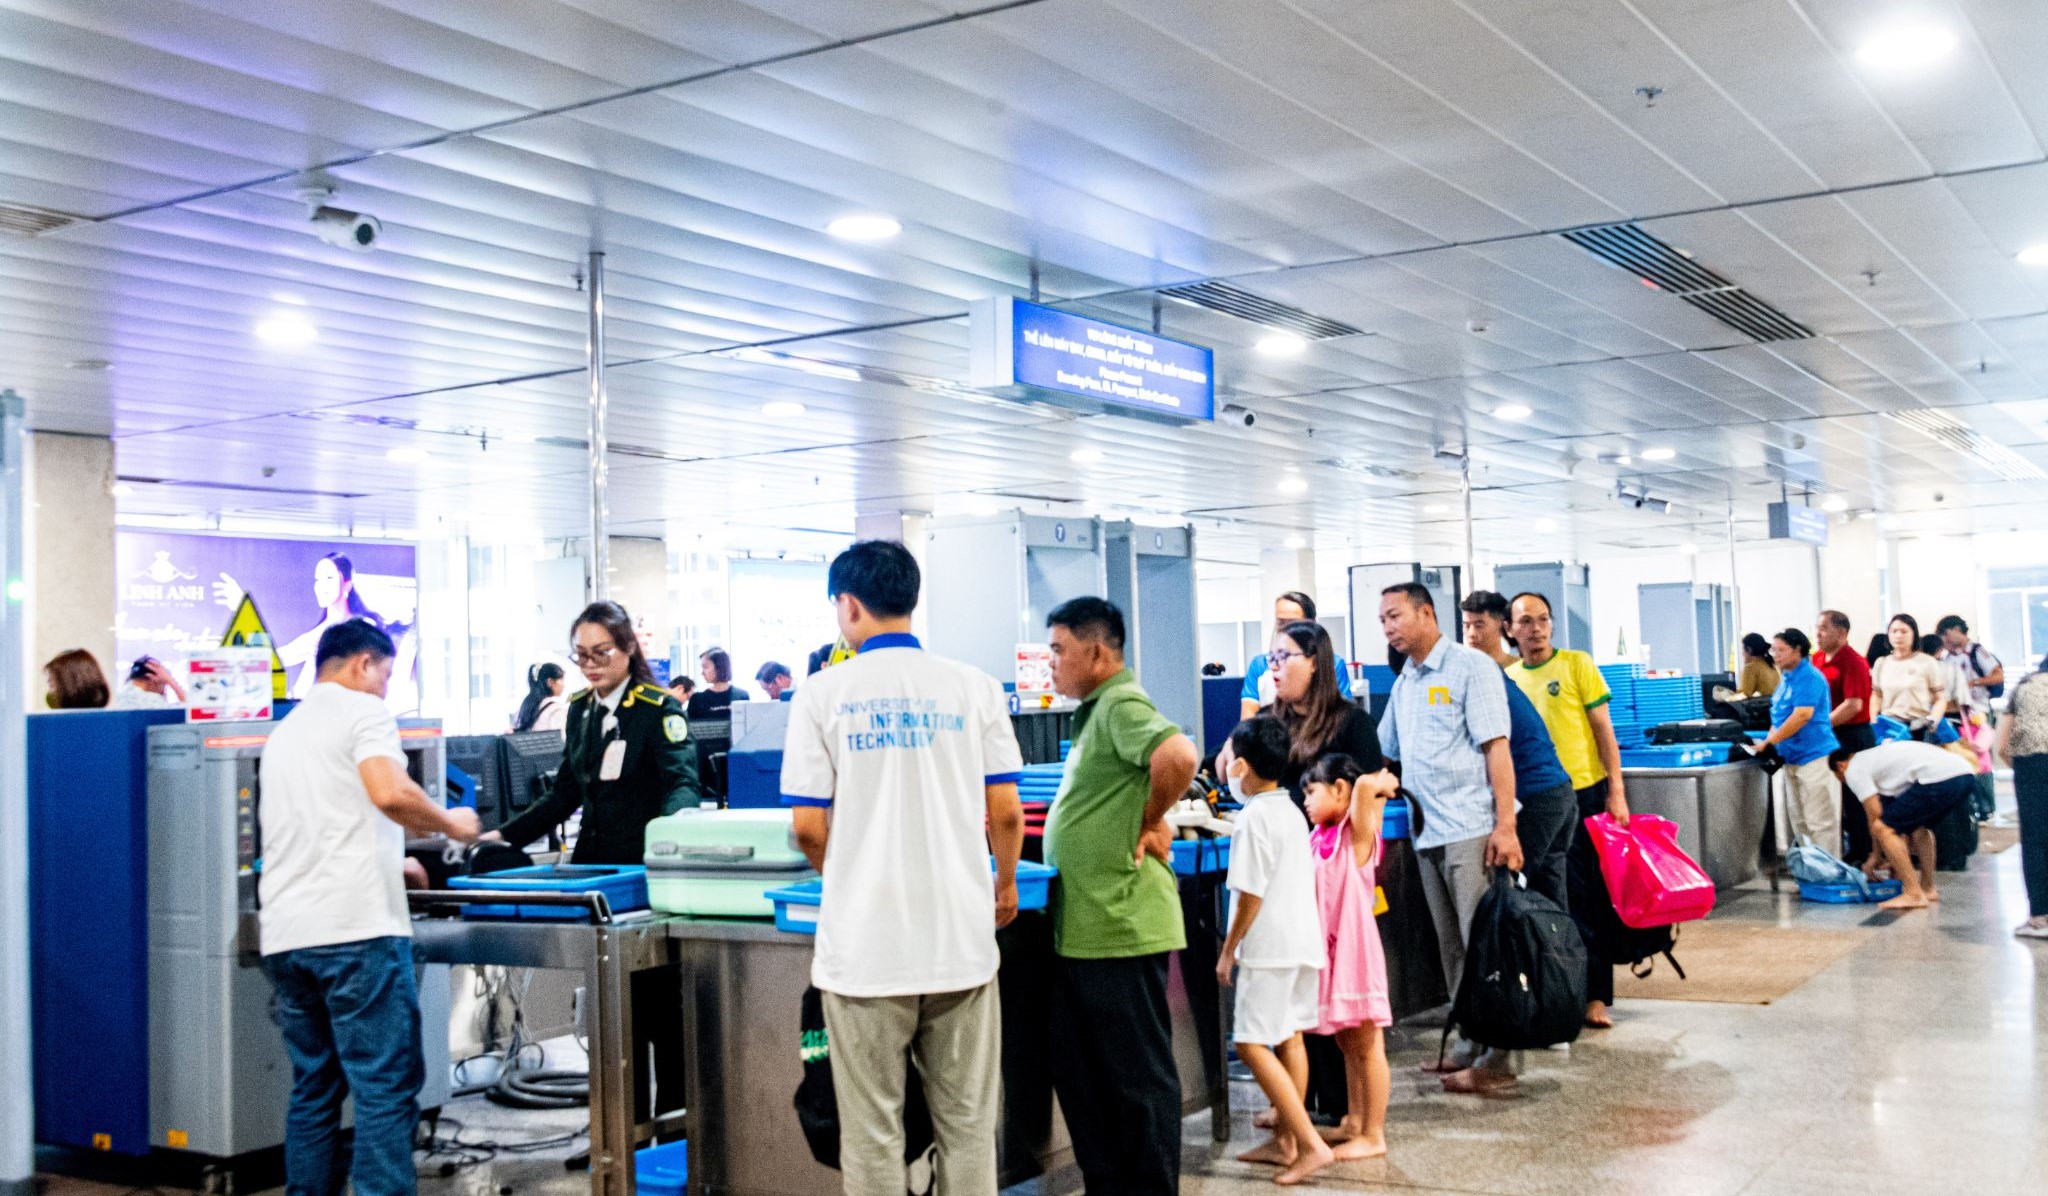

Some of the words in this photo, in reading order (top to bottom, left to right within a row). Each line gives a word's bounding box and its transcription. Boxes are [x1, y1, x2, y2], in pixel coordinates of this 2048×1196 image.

[120, 583, 164, 601] LINH
[166, 585, 205, 602] ANH
[869, 711, 966, 732] INFORMATION
[847, 731, 936, 751] TECHNOLOGY
